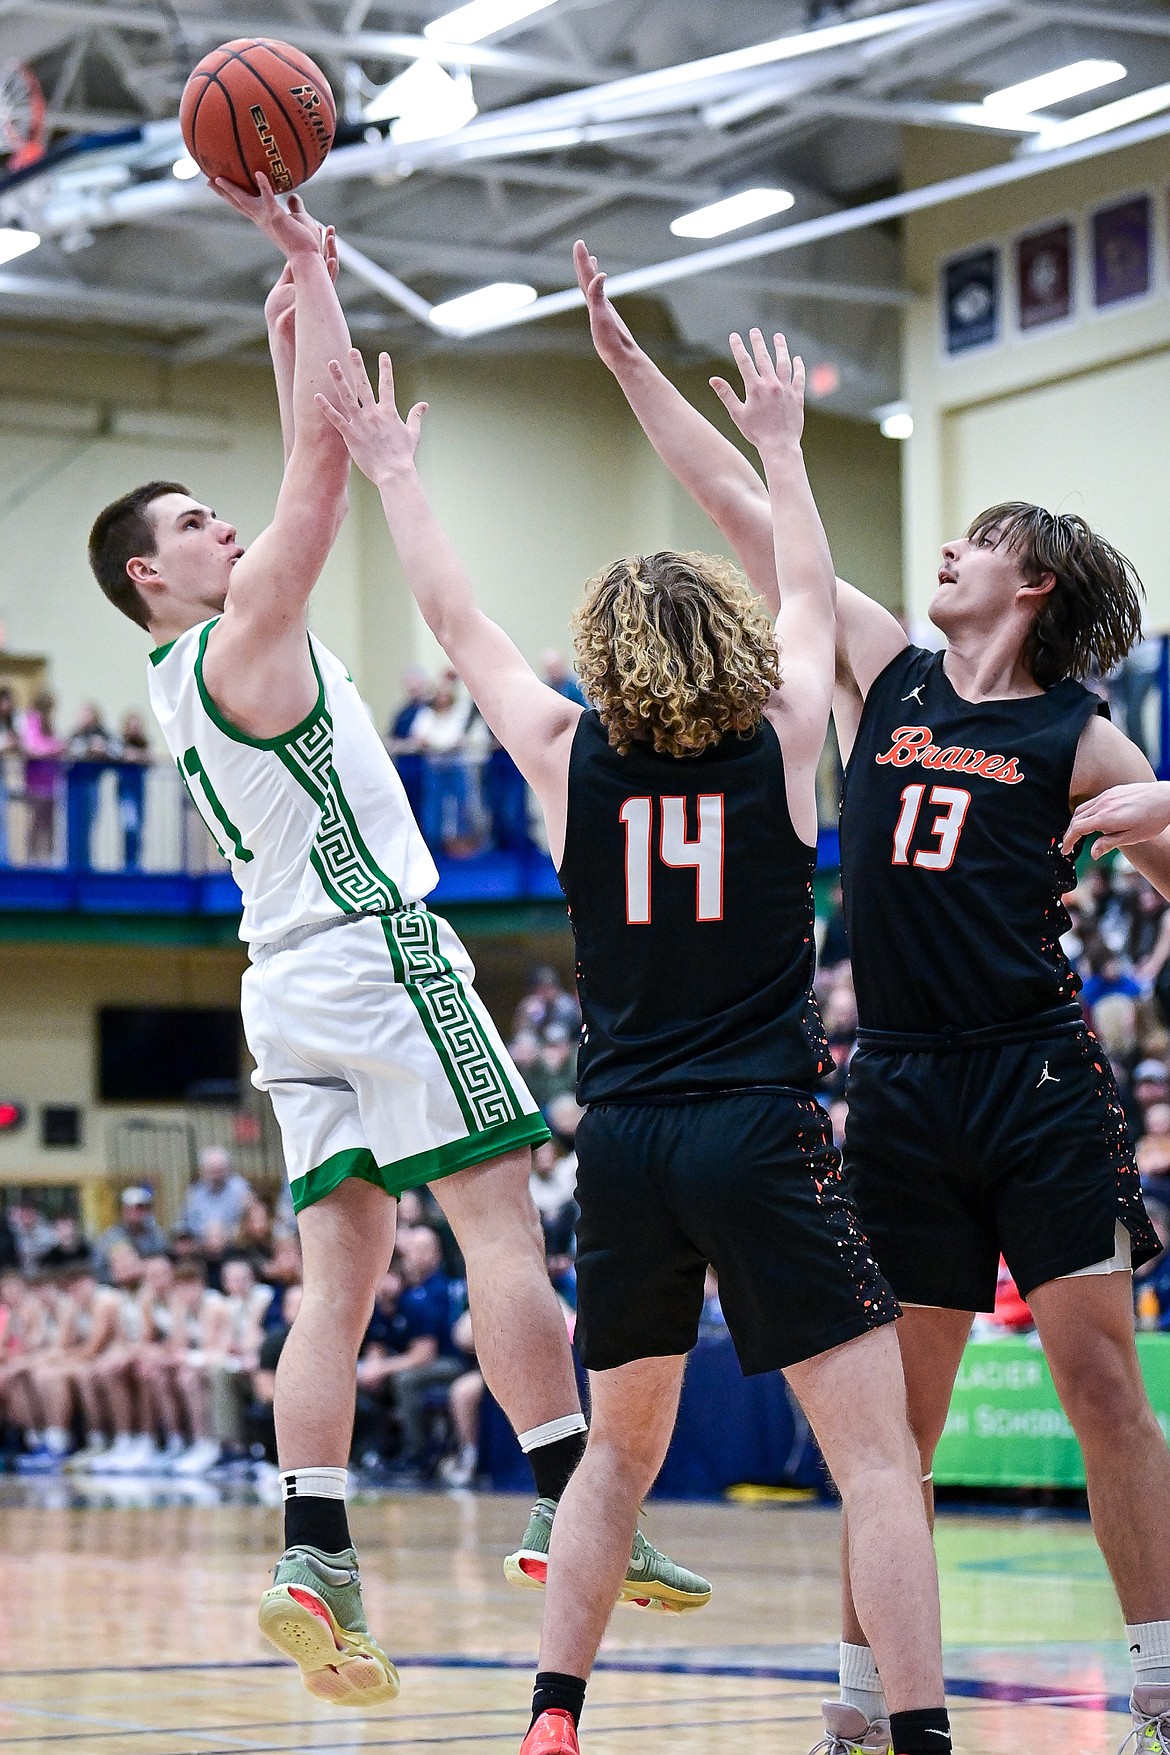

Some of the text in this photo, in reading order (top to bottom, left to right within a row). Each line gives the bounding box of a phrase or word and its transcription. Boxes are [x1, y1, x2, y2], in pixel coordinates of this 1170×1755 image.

[249, 104, 287, 174] ELITE
[875, 726, 1025, 784] Braves
[619, 793, 725, 925] 14
[891, 783, 971, 871] 13
